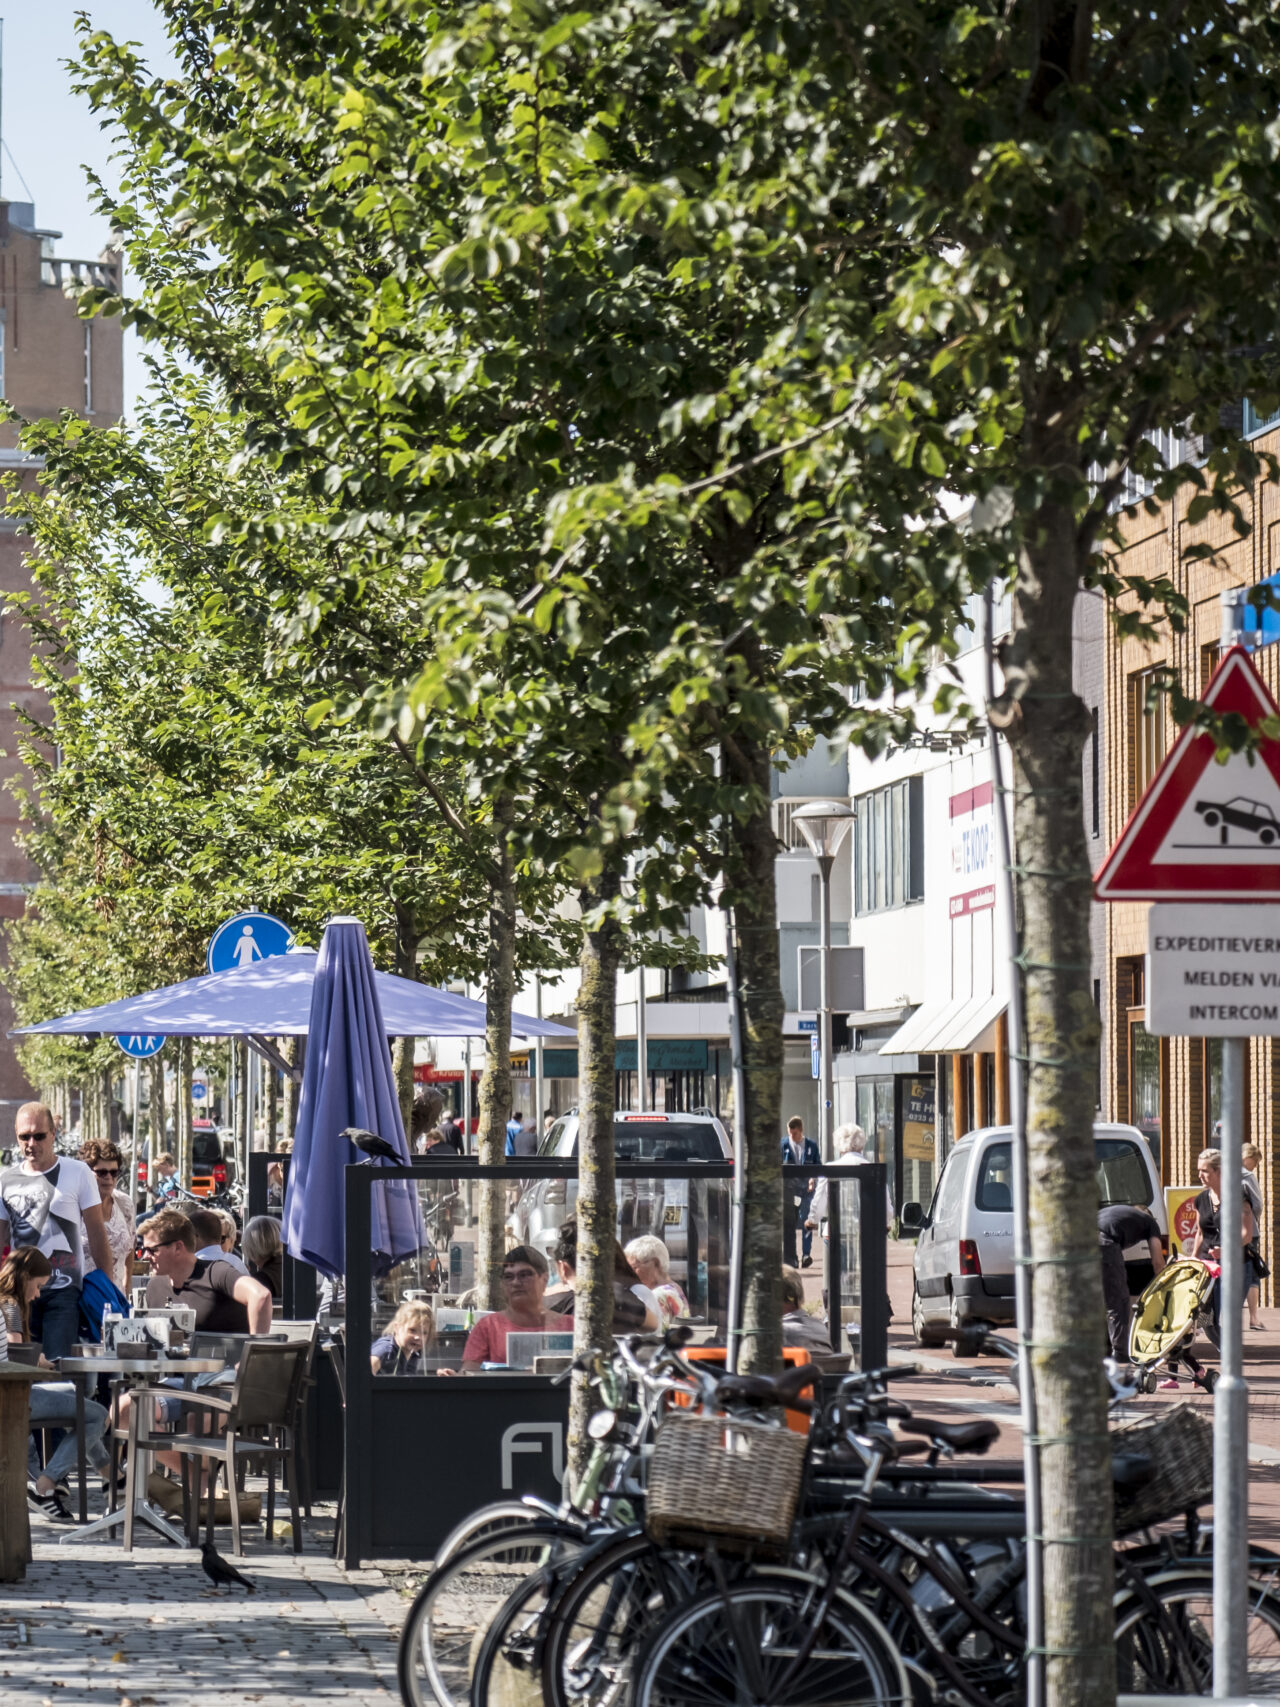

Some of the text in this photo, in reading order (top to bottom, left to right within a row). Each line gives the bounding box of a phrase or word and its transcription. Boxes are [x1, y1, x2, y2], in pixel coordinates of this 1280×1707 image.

[962, 823, 989, 874] TE KOOP
[1184, 971, 1254, 987] MELDEN
[1190, 1005, 1278, 1020] INTERCOM
[910, 1101, 921, 1112] TE
